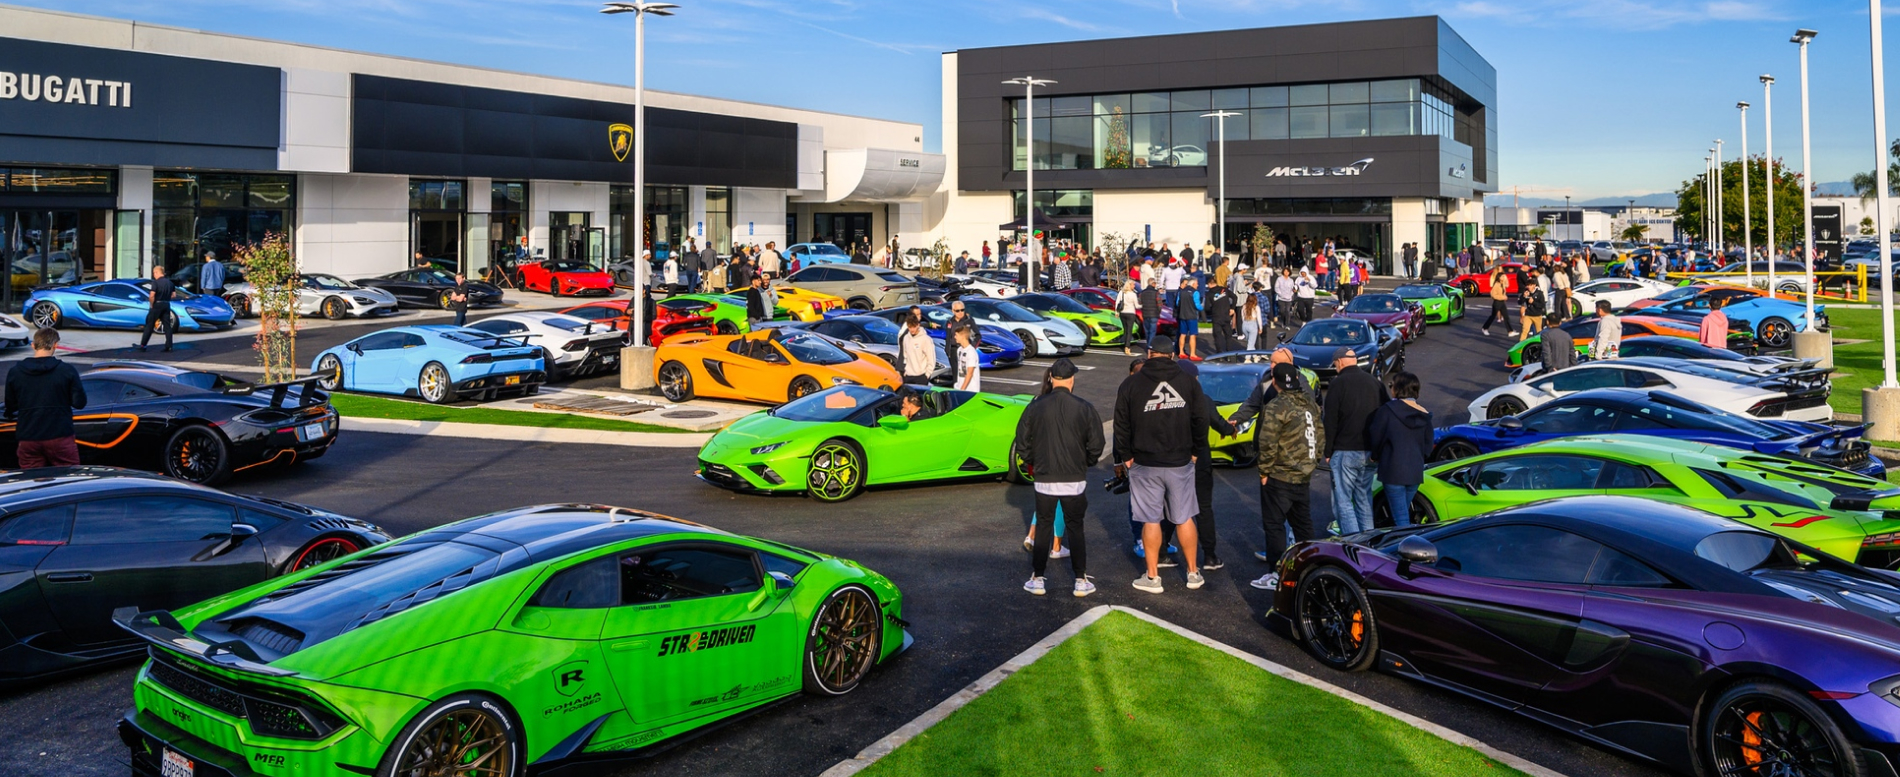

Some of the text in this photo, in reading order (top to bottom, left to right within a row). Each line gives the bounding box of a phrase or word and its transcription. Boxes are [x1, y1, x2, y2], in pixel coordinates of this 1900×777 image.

[0, 71, 131, 108] BUGATTI
[1264, 165, 1362, 178] McLaren
[1305, 410, 1317, 459] origins
[481, 700, 511, 731] Continental
[544, 692, 602, 716] ROHANA
[562, 697, 602, 715] FORGED
[254, 752, 285, 765] MFR
